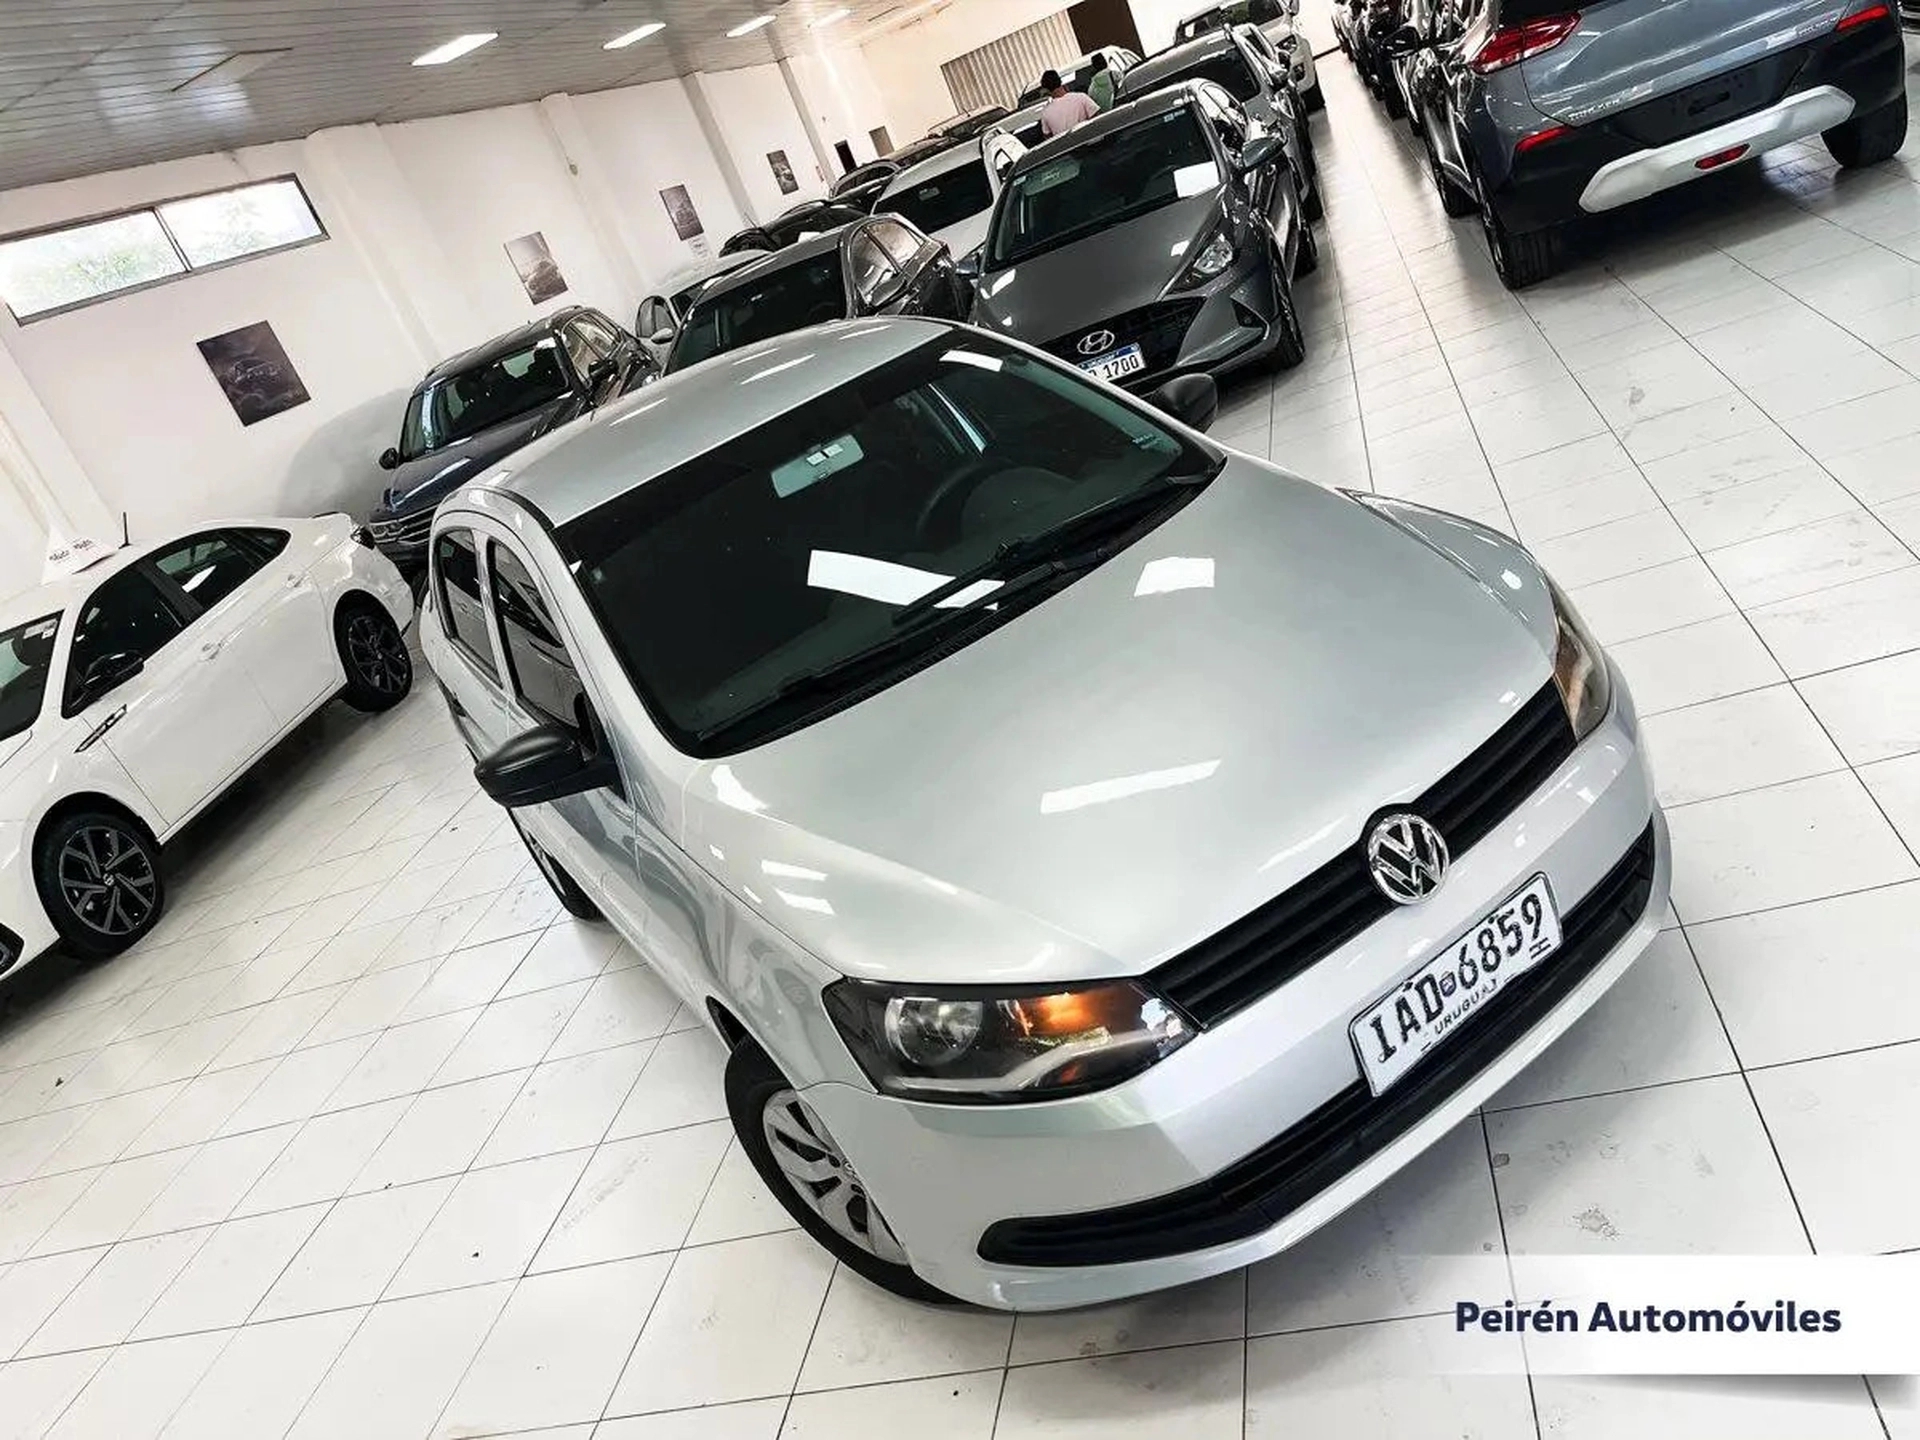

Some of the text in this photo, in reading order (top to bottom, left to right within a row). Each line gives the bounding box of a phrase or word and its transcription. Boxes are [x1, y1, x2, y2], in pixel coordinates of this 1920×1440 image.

[1102, 354, 1139, 379] 1700
[1369, 893, 1543, 1063] IAD 6859
